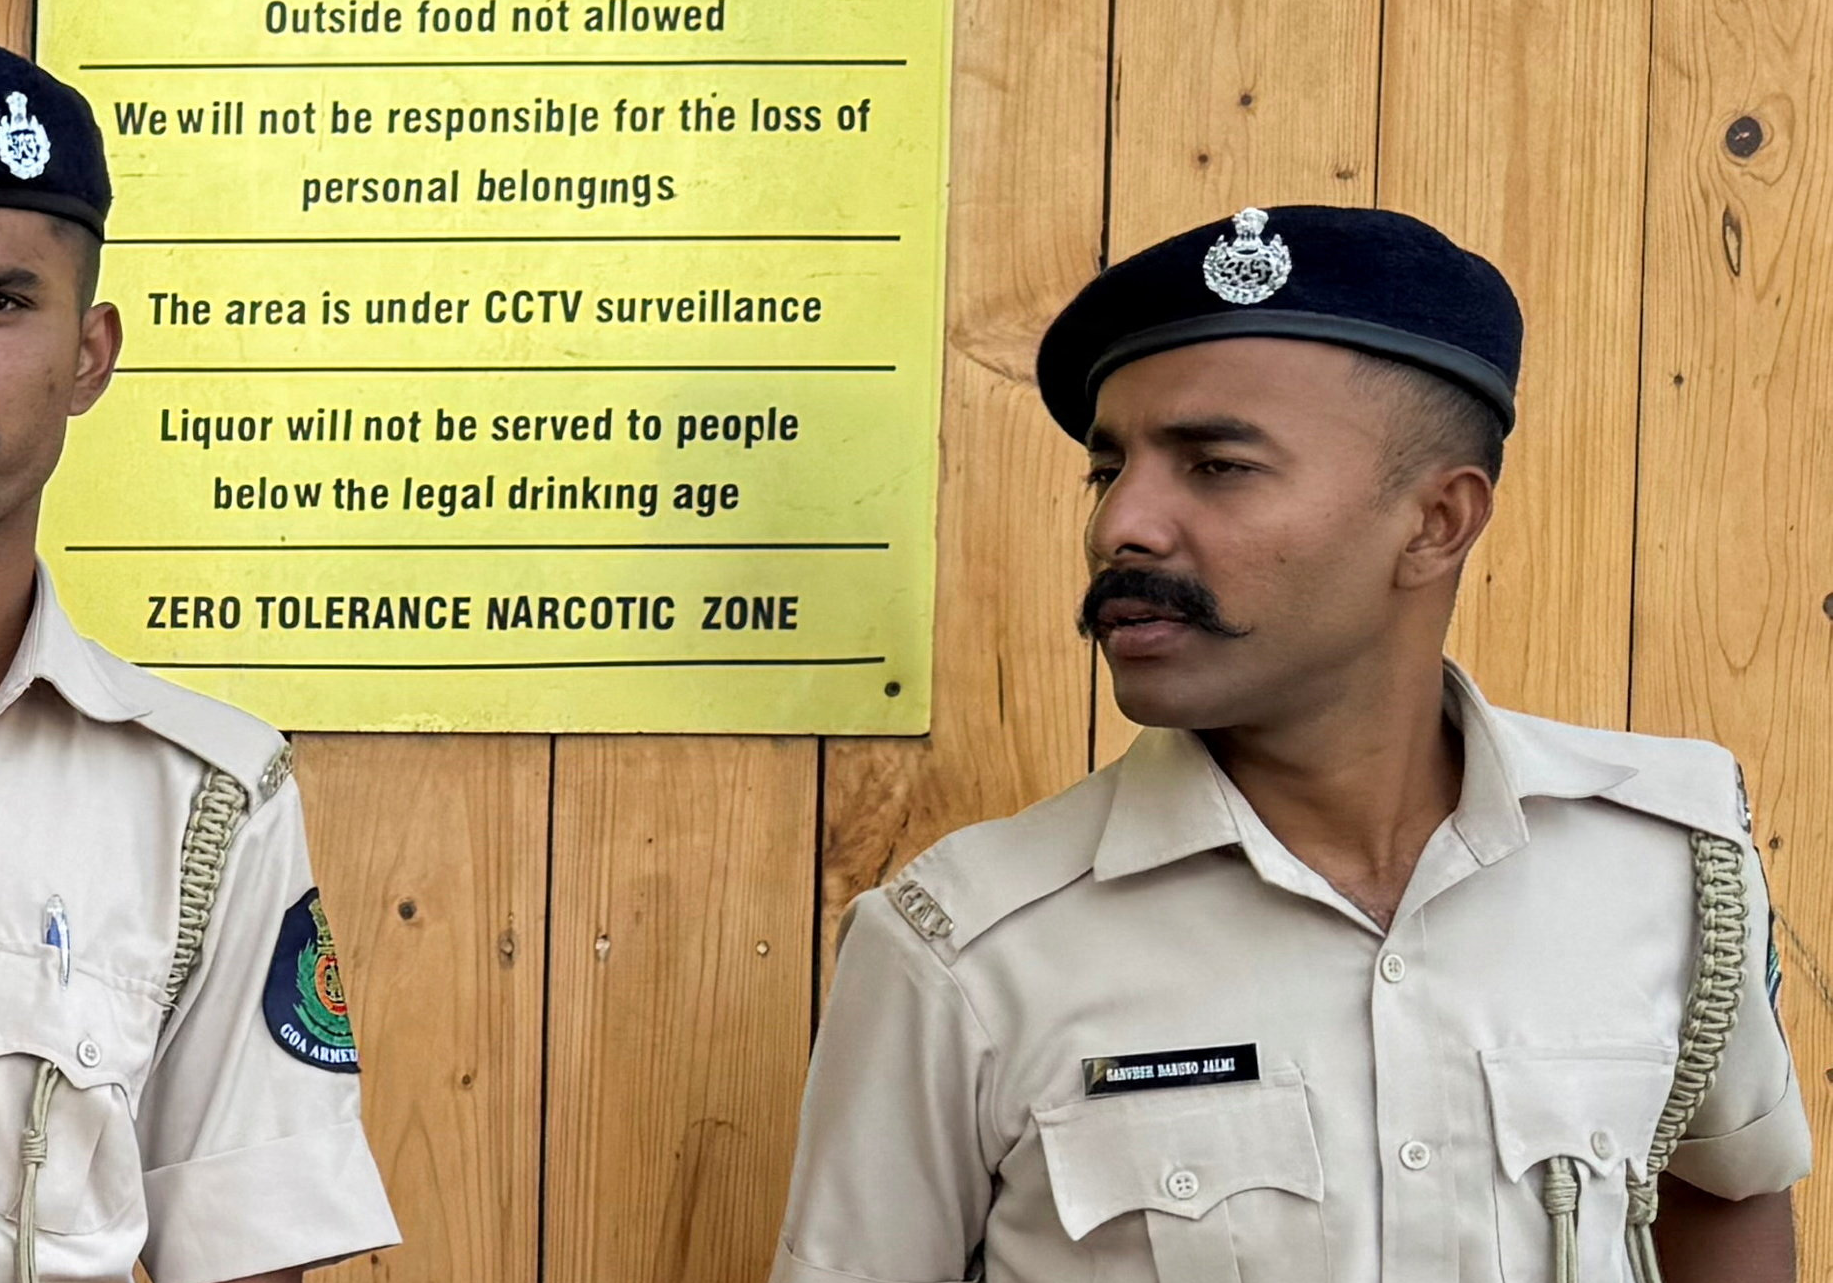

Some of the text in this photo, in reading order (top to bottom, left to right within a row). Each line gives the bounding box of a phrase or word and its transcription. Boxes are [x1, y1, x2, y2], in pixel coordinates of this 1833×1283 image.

[511, 0, 570, 33] not
[113, 96, 872, 142] We will not be responsible for the loss of
[301, 168, 676, 213] personal belongings
[147, 288, 823, 326] The area is under CCTV surveillance
[160, 405, 800, 451] Liquor will not be served to people
[213, 474, 740, 519] below the legal drinking age
[145, 594, 800, 632] ZERO TOLERANCE NARCOTIC ZONE
[279, 1022, 307, 1054] GOA
